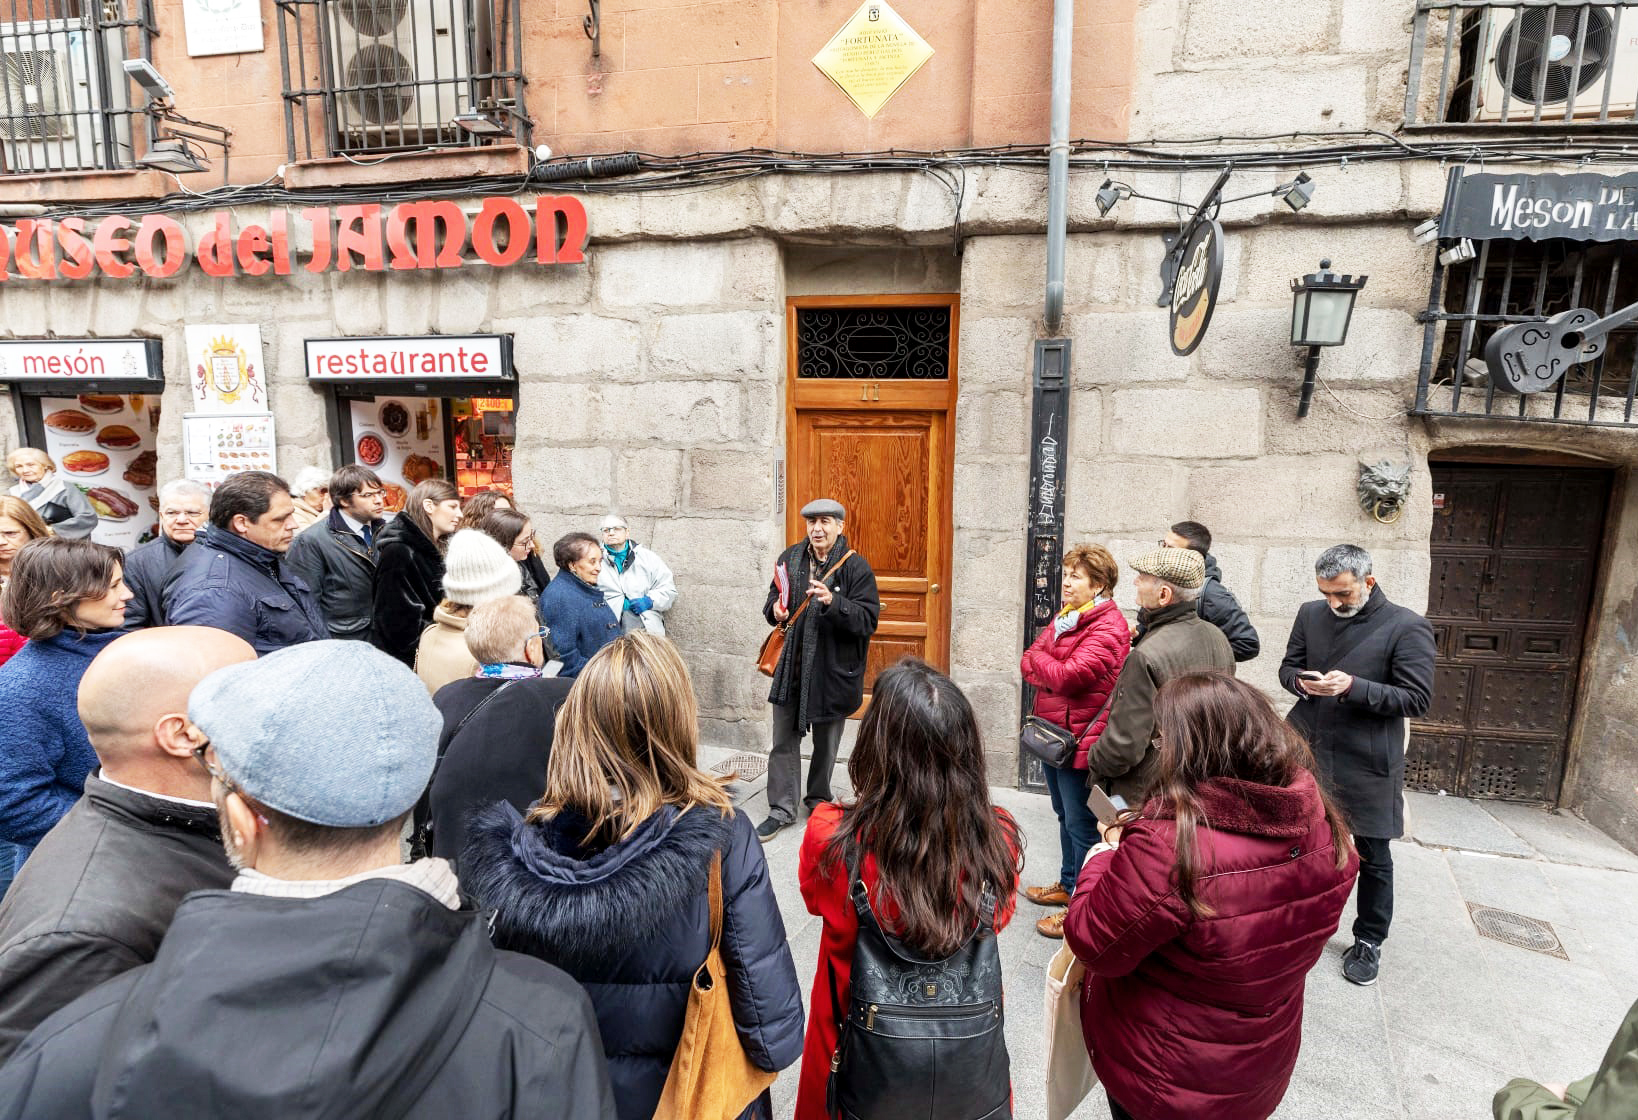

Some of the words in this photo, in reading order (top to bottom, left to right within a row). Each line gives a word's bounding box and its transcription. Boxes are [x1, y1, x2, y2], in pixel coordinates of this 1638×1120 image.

[1490, 183, 1593, 230] Meson
[1598, 186, 1635, 206] DE
[0, 214, 186, 281] USEO
[198, 209, 293, 277] del
[303, 195, 588, 273] JAMON
[23, 348, 105, 376] mesón
[316, 347, 489, 375] restaurante
[861, 383, 880, 401] 11
